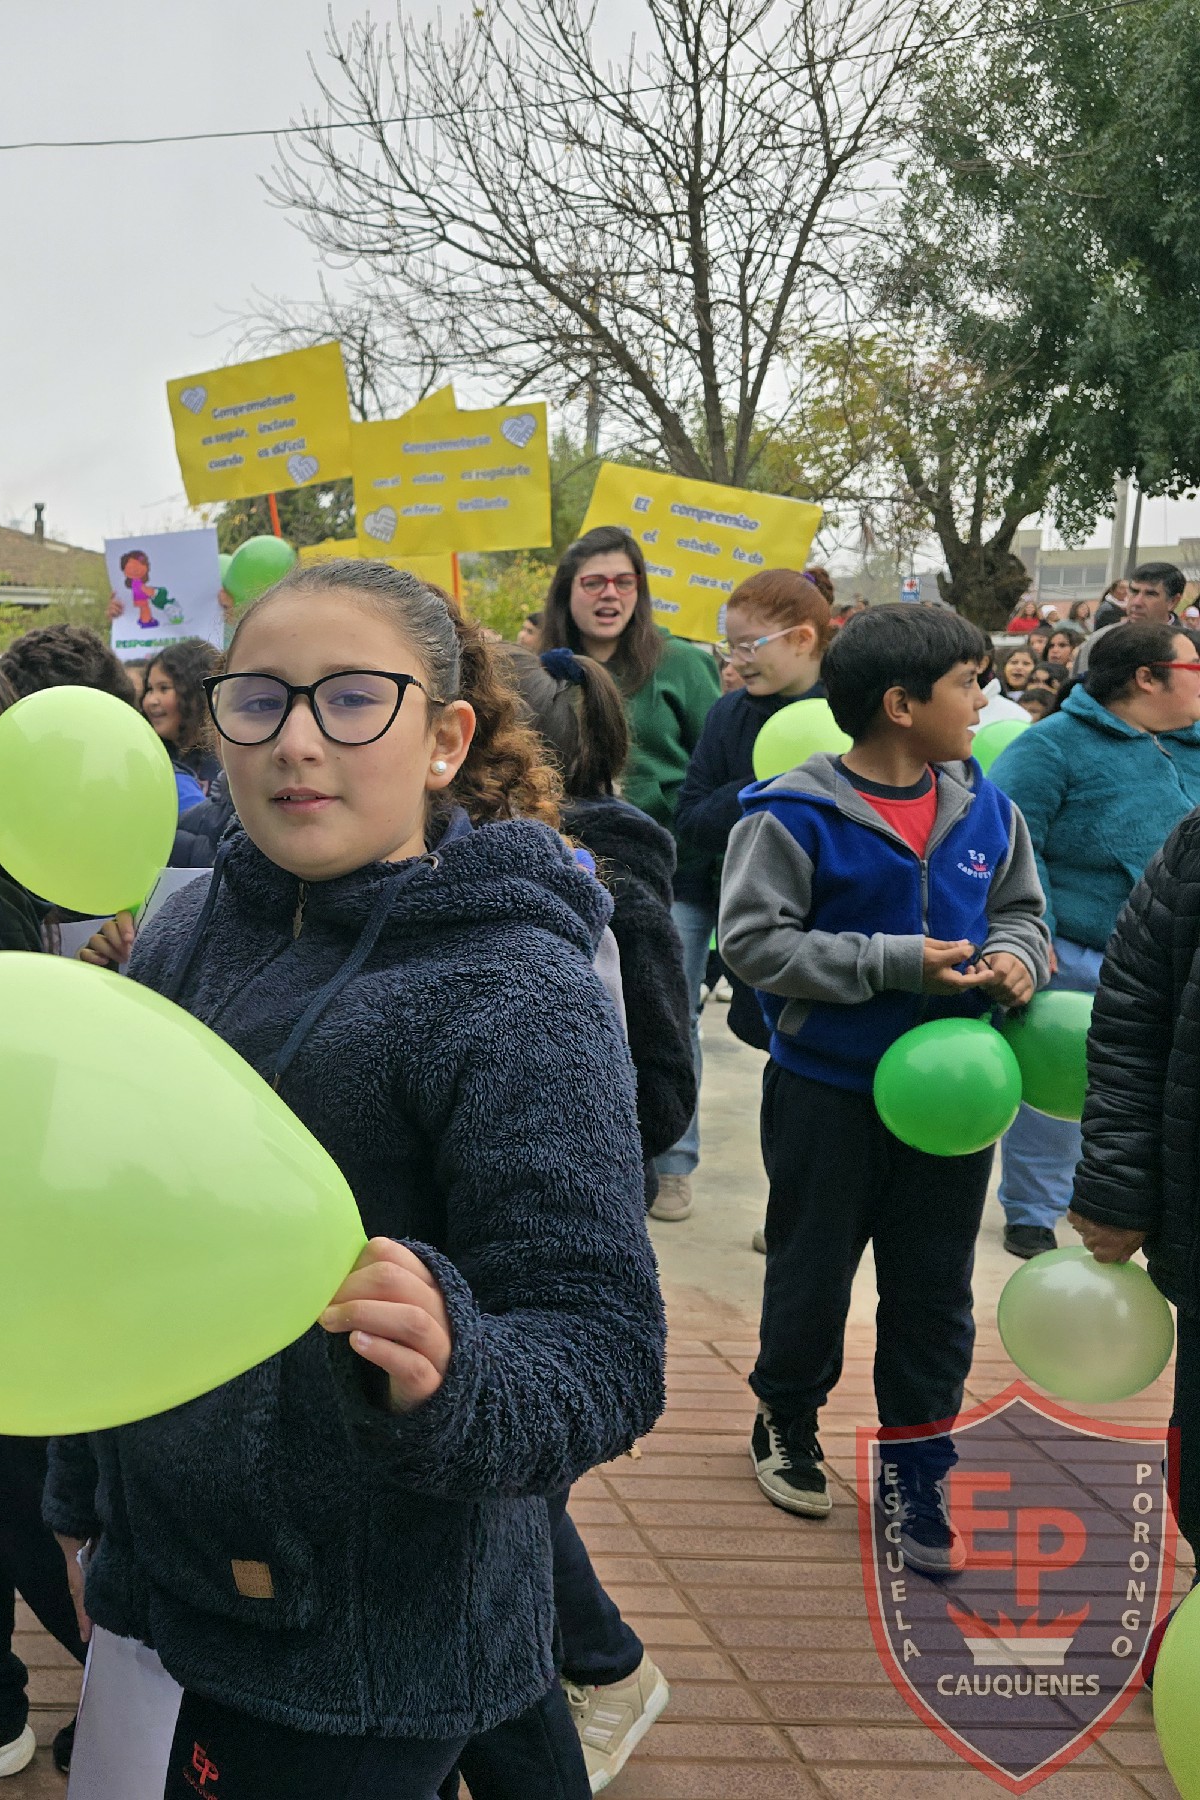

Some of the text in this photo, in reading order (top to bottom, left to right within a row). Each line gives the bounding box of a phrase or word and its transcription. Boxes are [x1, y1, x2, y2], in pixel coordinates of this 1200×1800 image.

[671, 503, 760, 531] compromiso
[677, 538, 721, 555] estudio
[733, 547, 746, 560] te
[748, 551, 764, 565] da
[689, 573, 718, 587] para
